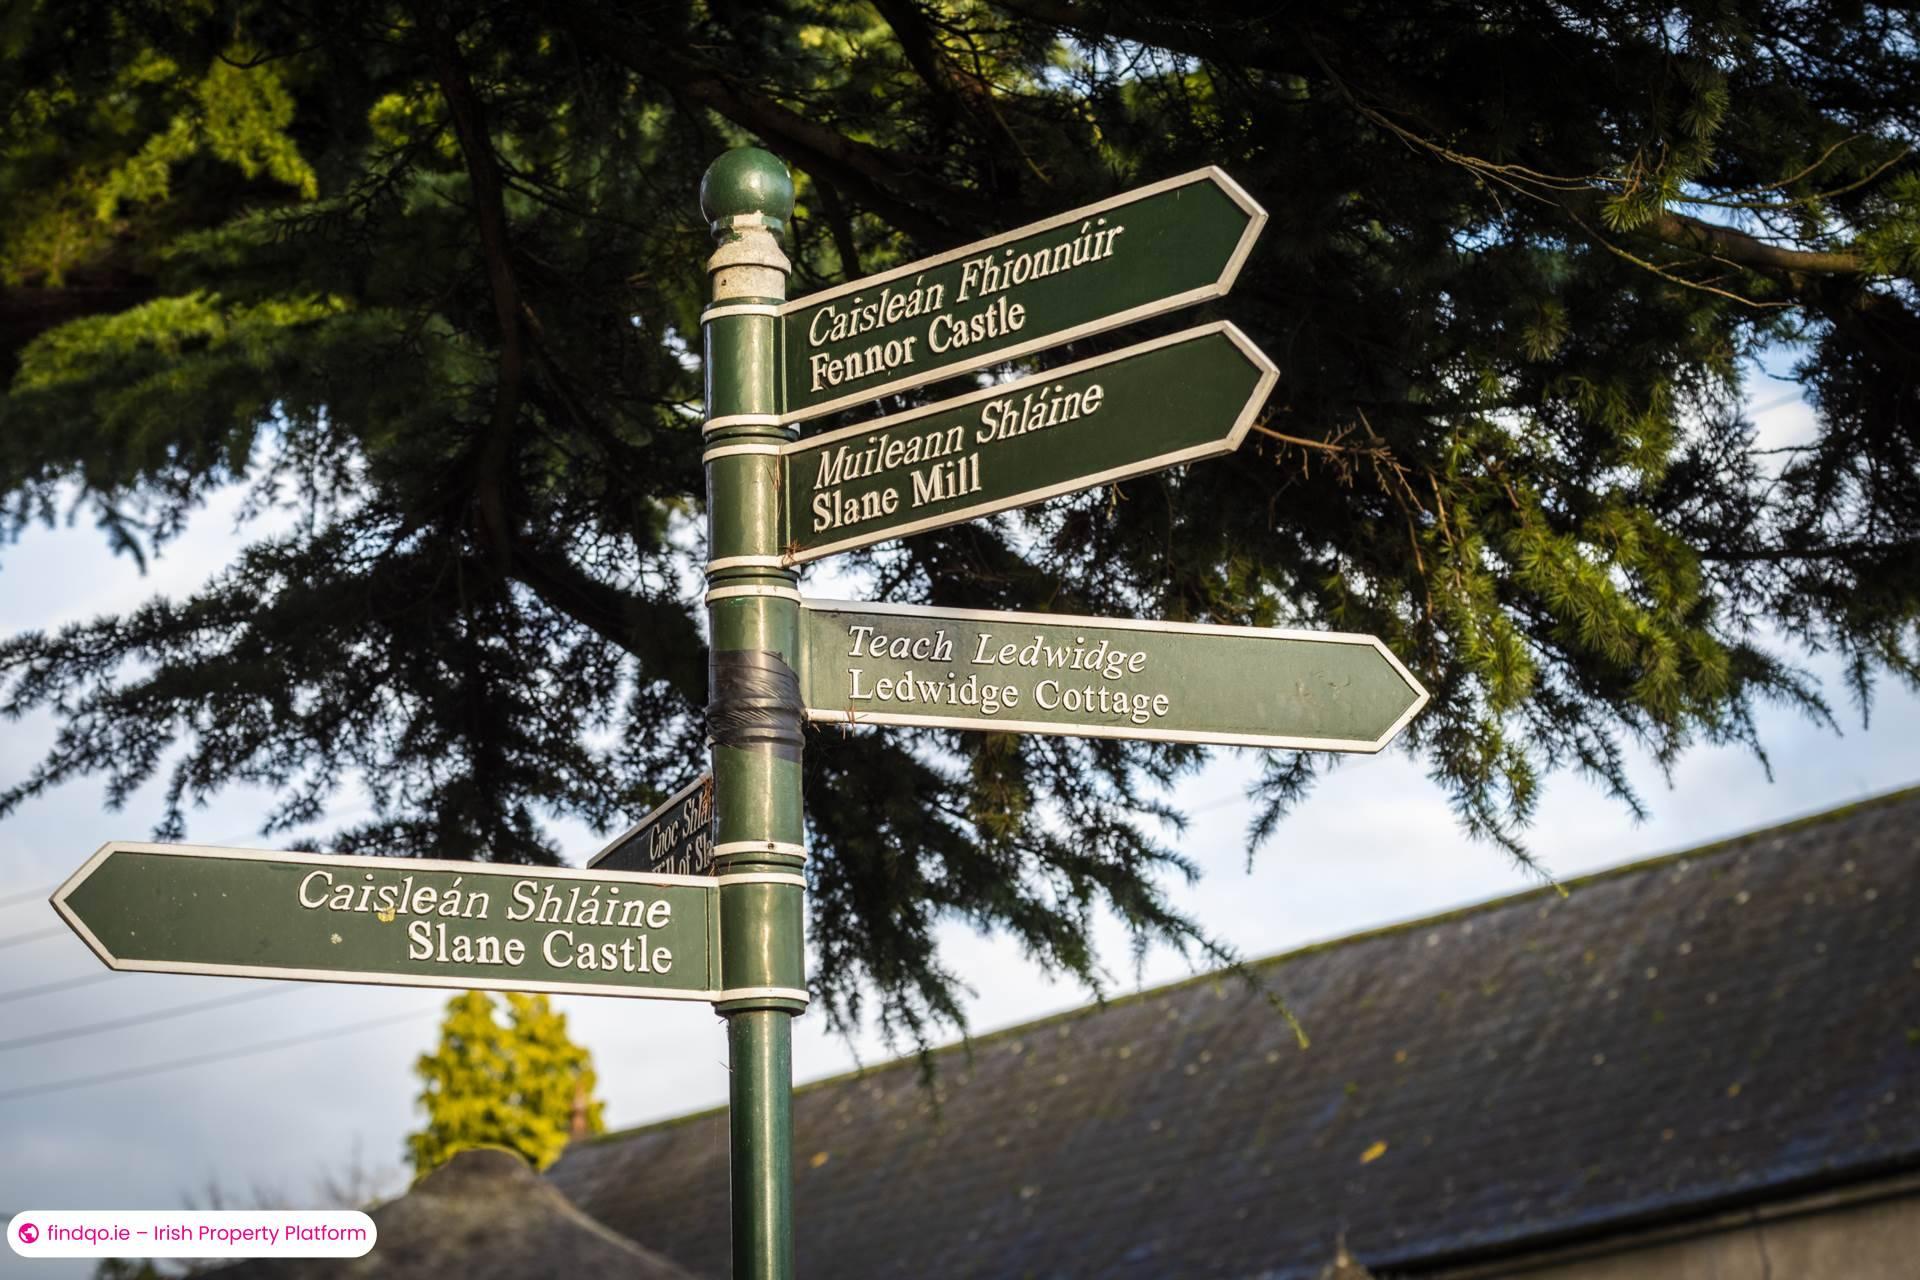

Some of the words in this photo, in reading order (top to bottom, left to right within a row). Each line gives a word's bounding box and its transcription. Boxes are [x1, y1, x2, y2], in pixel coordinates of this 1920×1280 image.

[808, 275, 944, 347] Caisleán
[956, 218, 1124, 303] Fhionnúir
[810, 335, 918, 392] Fennor
[928, 296, 1025, 353] Castle
[813, 424, 964, 490] Muileann
[976, 383, 1104, 445] Shláine
[812, 486, 899, 532] Slane
[910, 452, 982, 508] Mill
[848, 625, 953, 661] Teach
[972, 633, 1147, 679] Ledwidge
[848, 669, 1019, 714] Ledwidge
[1033, 680, 1169, 723] Cottage
[649, 820, 679, 861] Cnoc
[695, 832, 714, 872] Sla
[299, 870, 490, 919] Caisleán
[506, 880, 672, 929] Shláine
[407, 921, 526, 966] Slane
[543, 930, 673, 973] Castle
